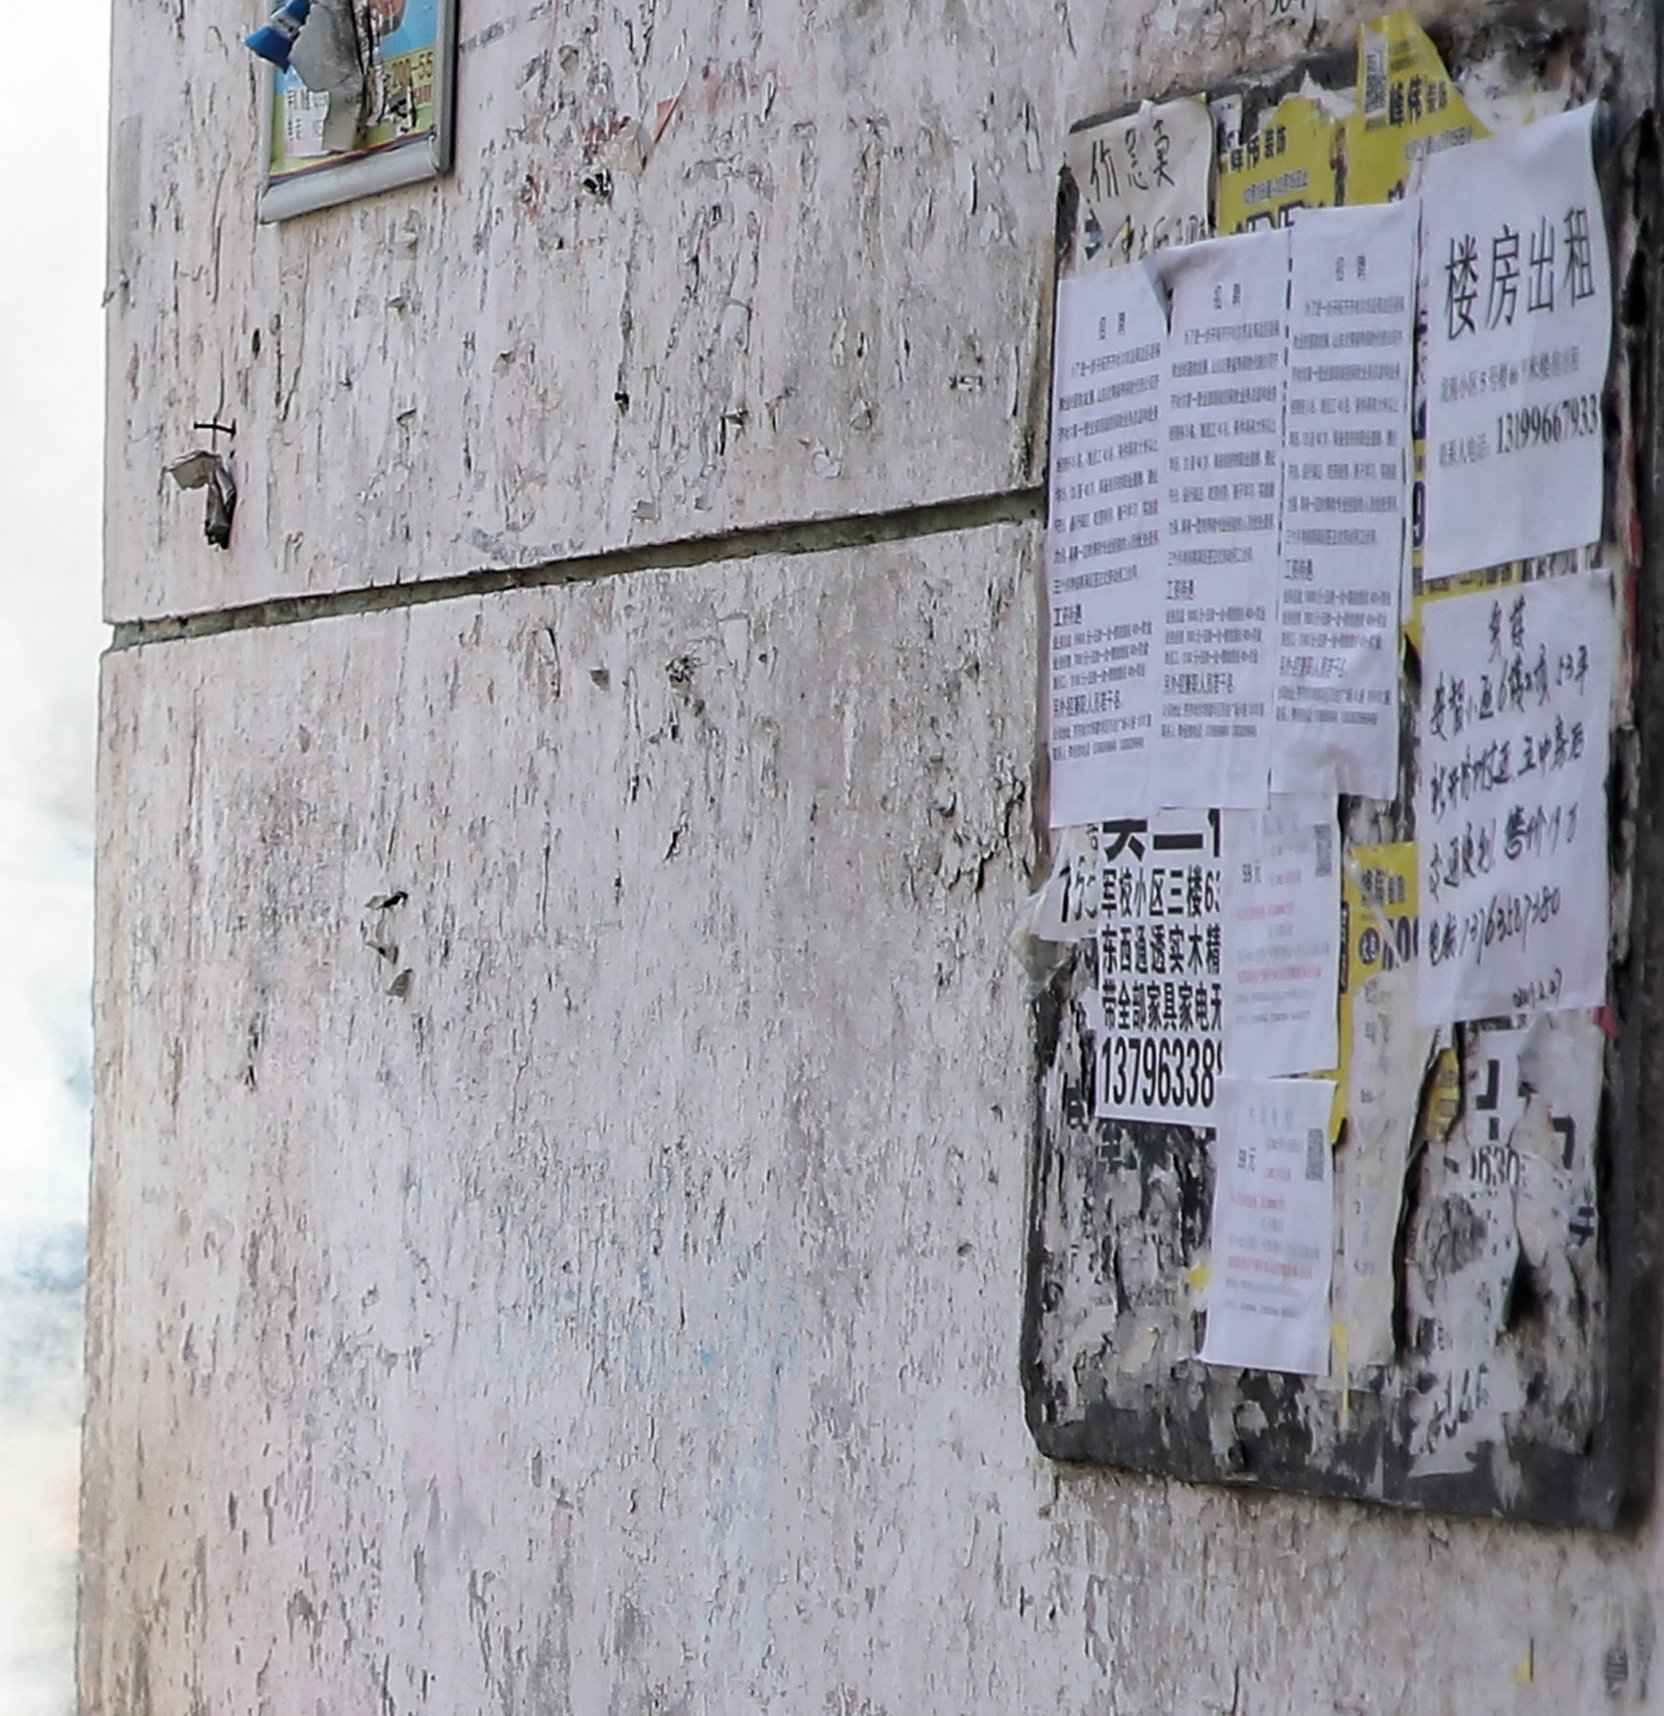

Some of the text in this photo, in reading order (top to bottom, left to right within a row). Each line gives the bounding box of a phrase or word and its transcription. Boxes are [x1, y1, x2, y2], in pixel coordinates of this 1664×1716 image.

[1444, 205, 1596, 342] 楼房出租
[1101, 1037, 1222, 1108] 13796338
